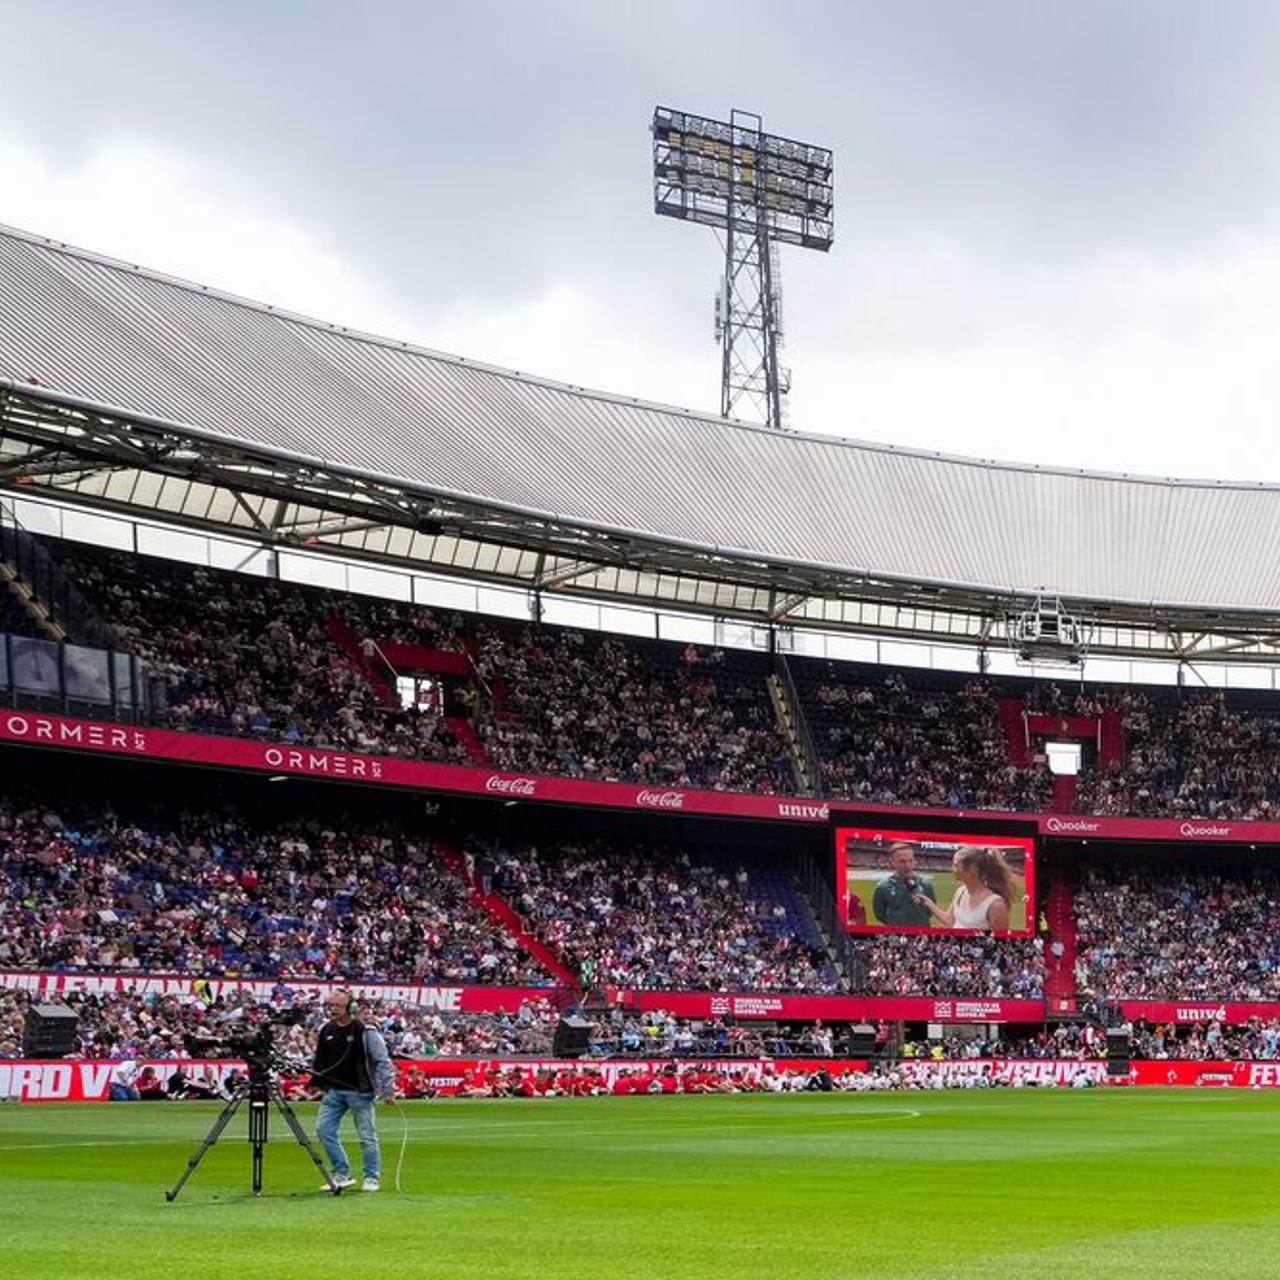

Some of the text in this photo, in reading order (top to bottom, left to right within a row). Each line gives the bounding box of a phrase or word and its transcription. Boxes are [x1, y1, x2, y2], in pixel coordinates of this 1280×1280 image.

[7, 716, 128, 748] ORMER
[265, 749, 366, 776] ORMER
[778, 803, 830, 819] univé
[1047, 817, 1100, 832] Quooker
[1180, 822, 1230, 837] Quooker
[1177, 1005, 1227, 1021] univé
